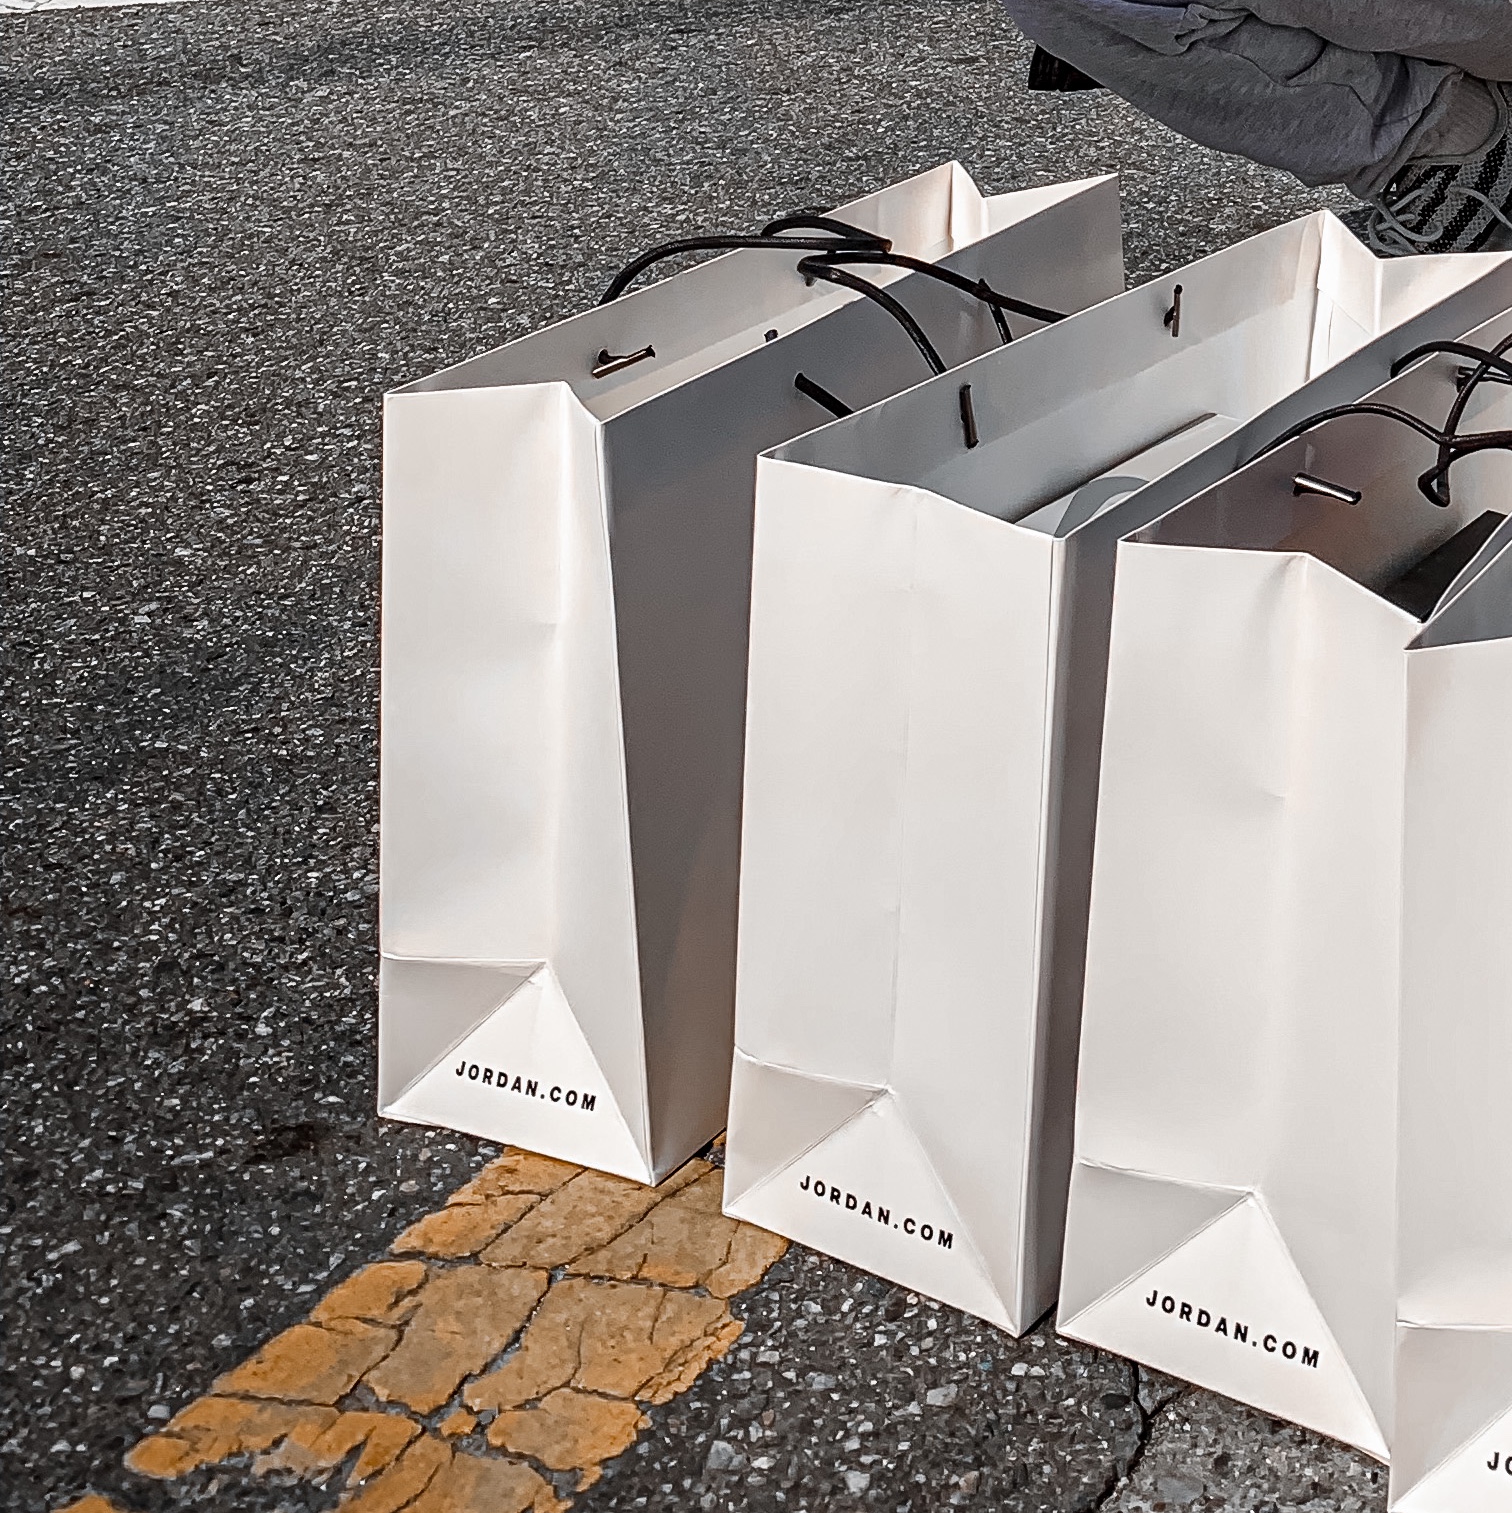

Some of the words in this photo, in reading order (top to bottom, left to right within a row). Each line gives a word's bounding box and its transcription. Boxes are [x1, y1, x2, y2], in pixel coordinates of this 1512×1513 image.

[456, 1061, 596, 1111] JORDAN.COM
[799, 1174, 955, 1249] JORDAN.COM
[1145, 1289, 1320, 1369] JORDAN.COM
